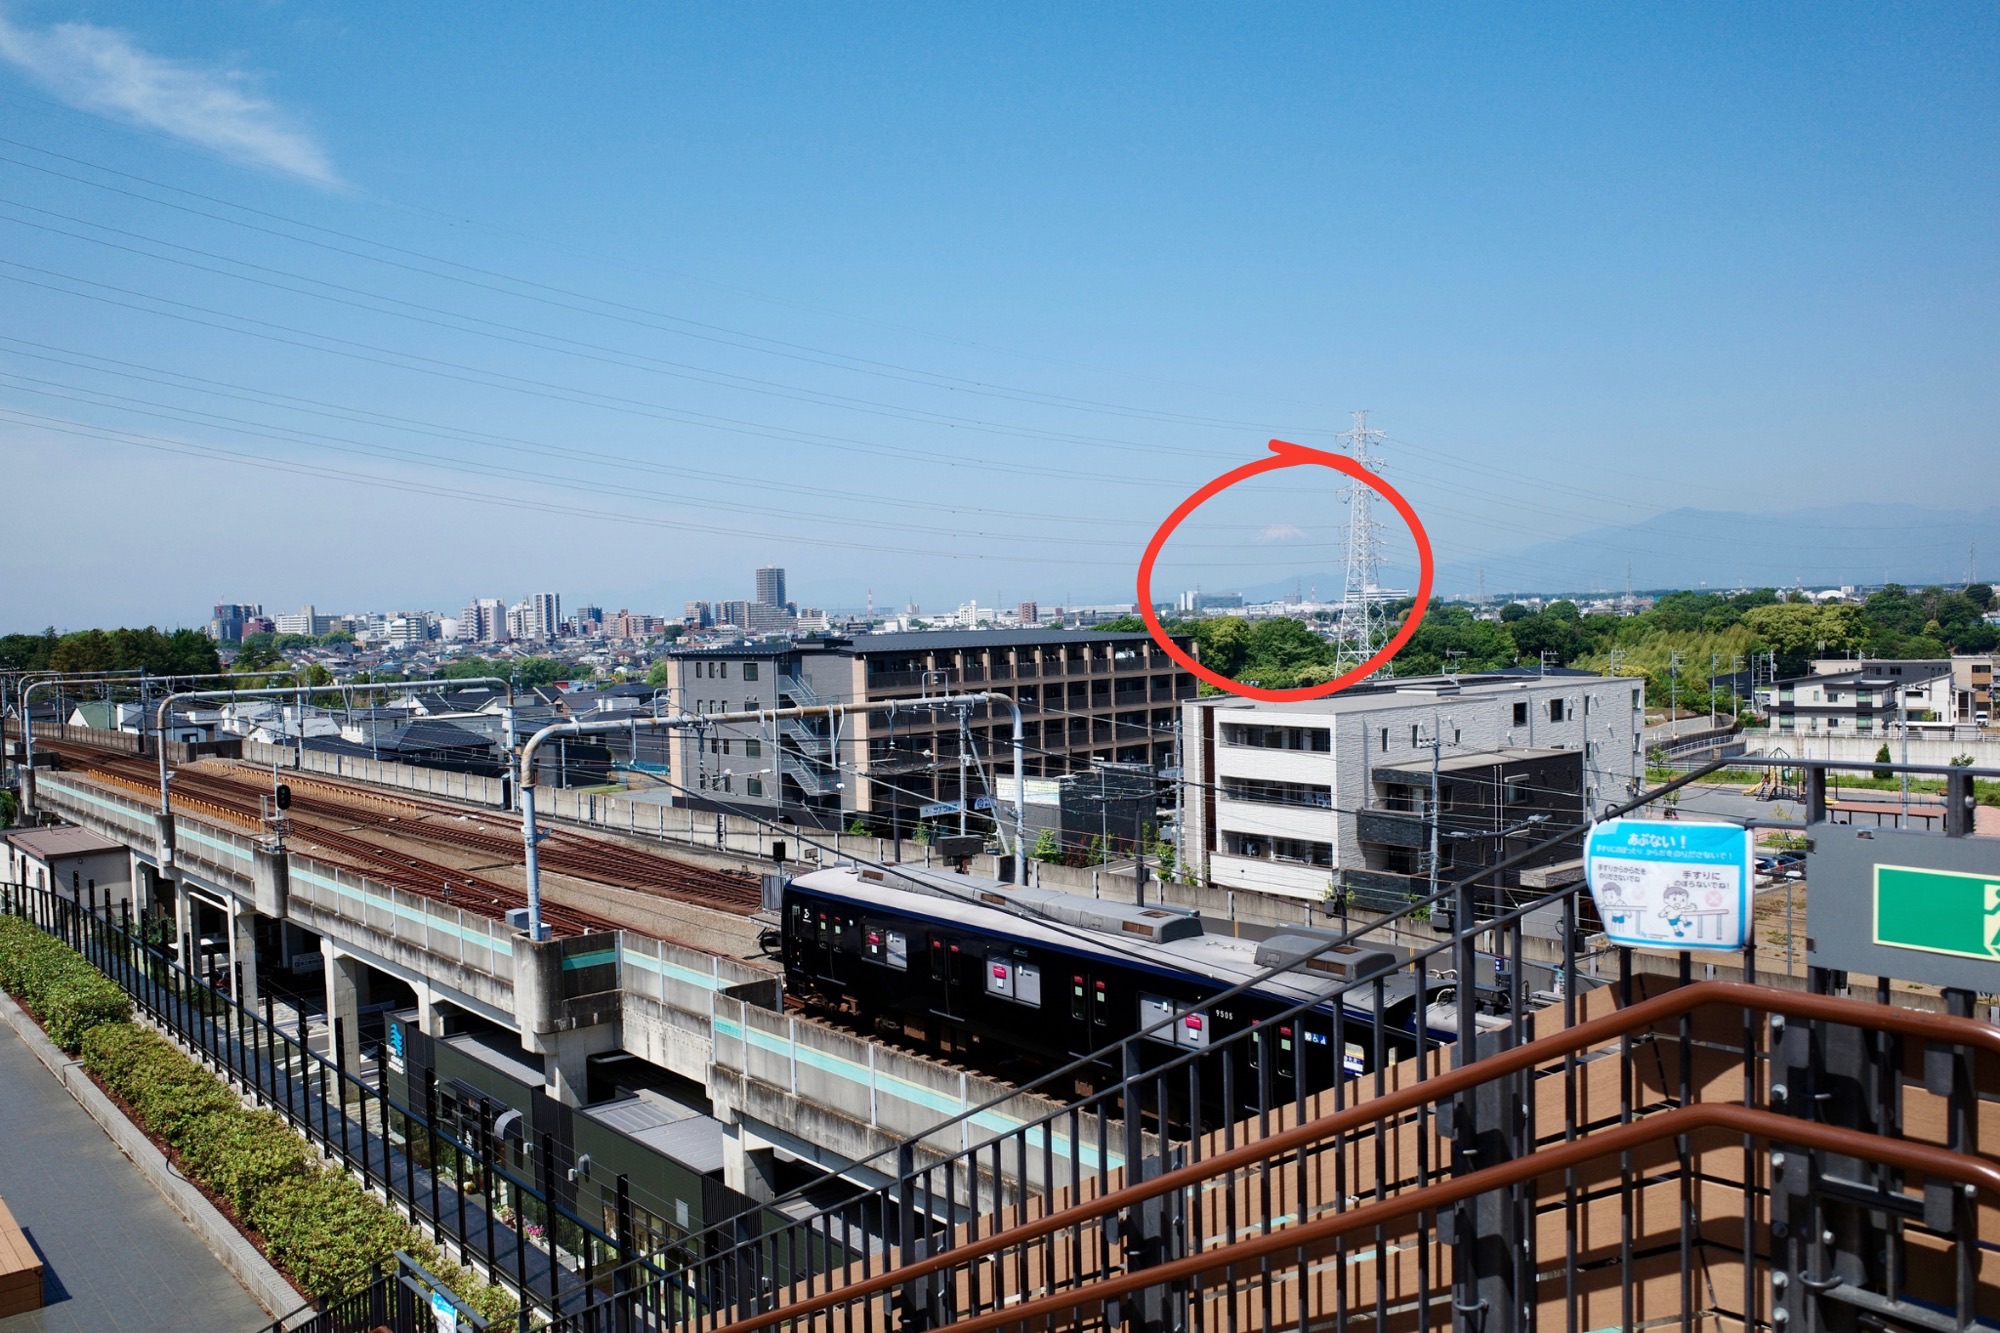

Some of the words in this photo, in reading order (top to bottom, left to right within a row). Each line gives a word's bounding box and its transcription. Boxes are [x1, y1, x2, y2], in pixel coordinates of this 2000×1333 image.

[1628, 833, 1686, 849] あぶない！
[1682, 870, 1720, 880] 手すりに
[1215, 1009, 1233, 1020] 9505
